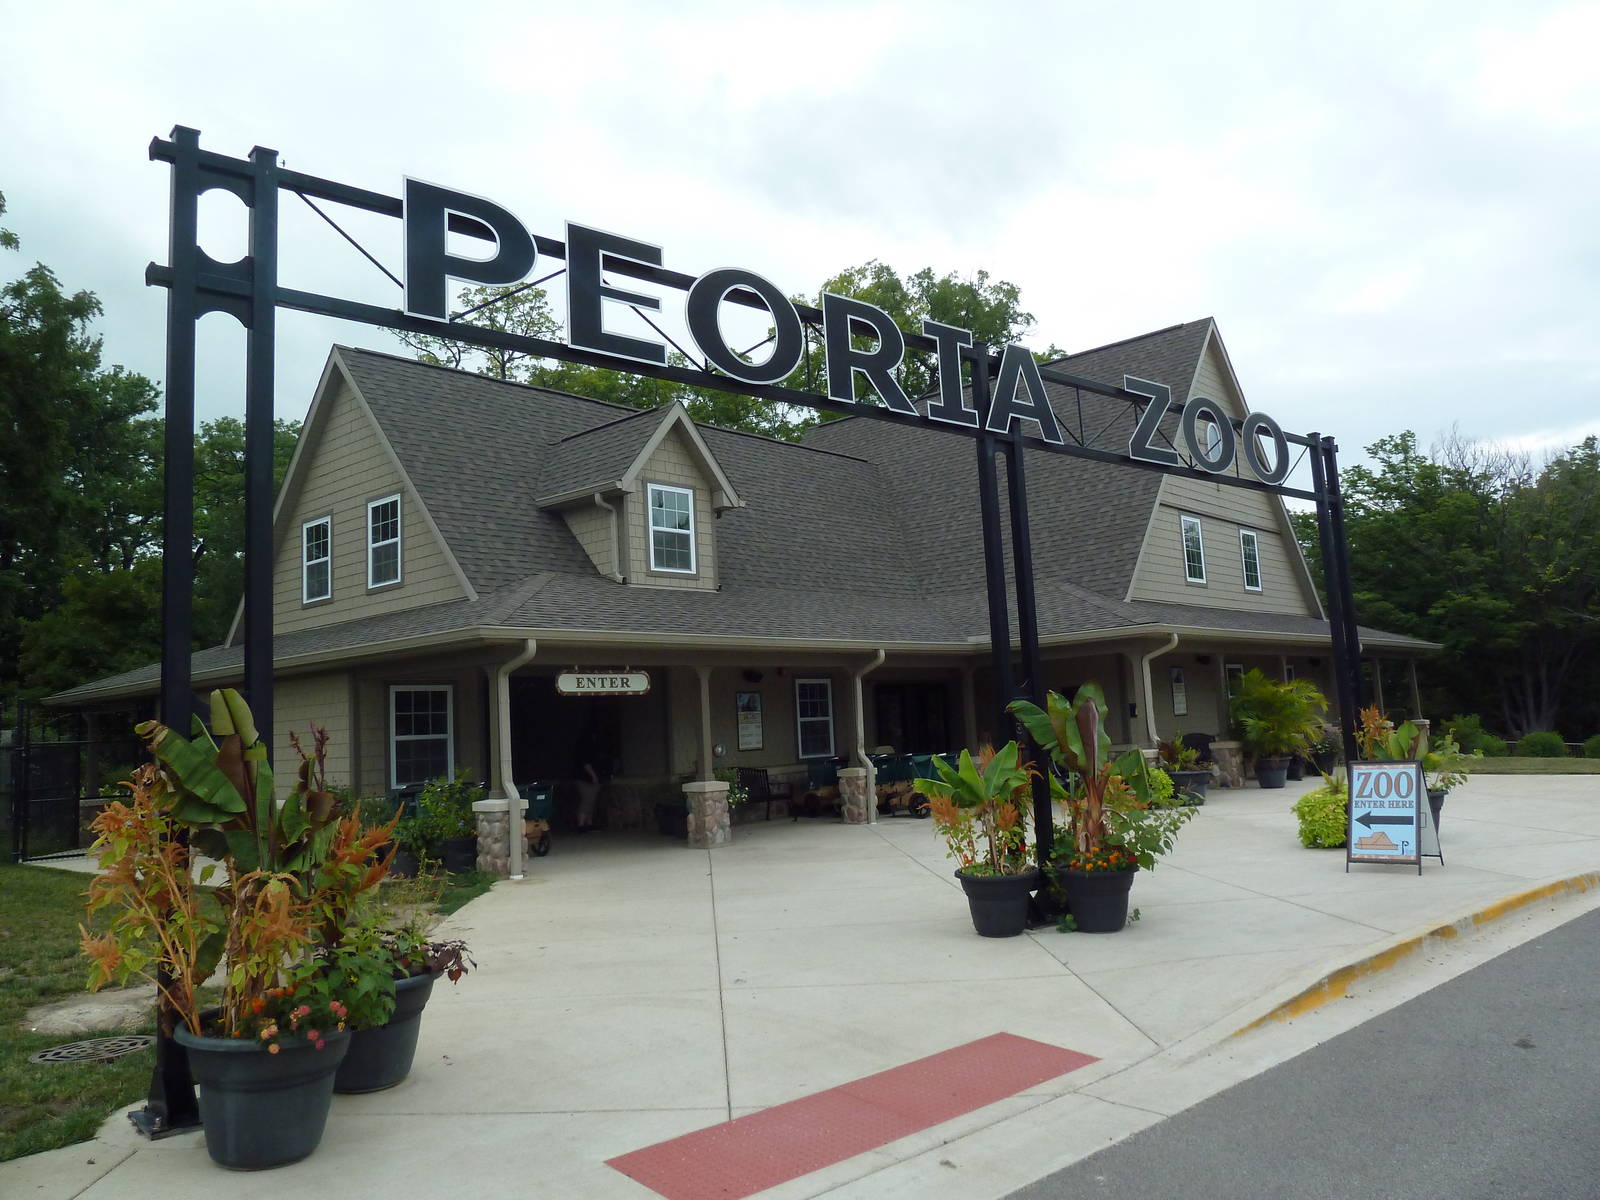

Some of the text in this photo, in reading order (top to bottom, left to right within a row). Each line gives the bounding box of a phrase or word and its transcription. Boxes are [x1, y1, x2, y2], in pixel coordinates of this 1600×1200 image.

[403, 174, 1290, 485] PEORIA ZOO
[576, 677, 631, 688] ENTER
[1356, 771, 1414, 799] ZOO
[1354, 800, 1414, 808] ENTER HERE
